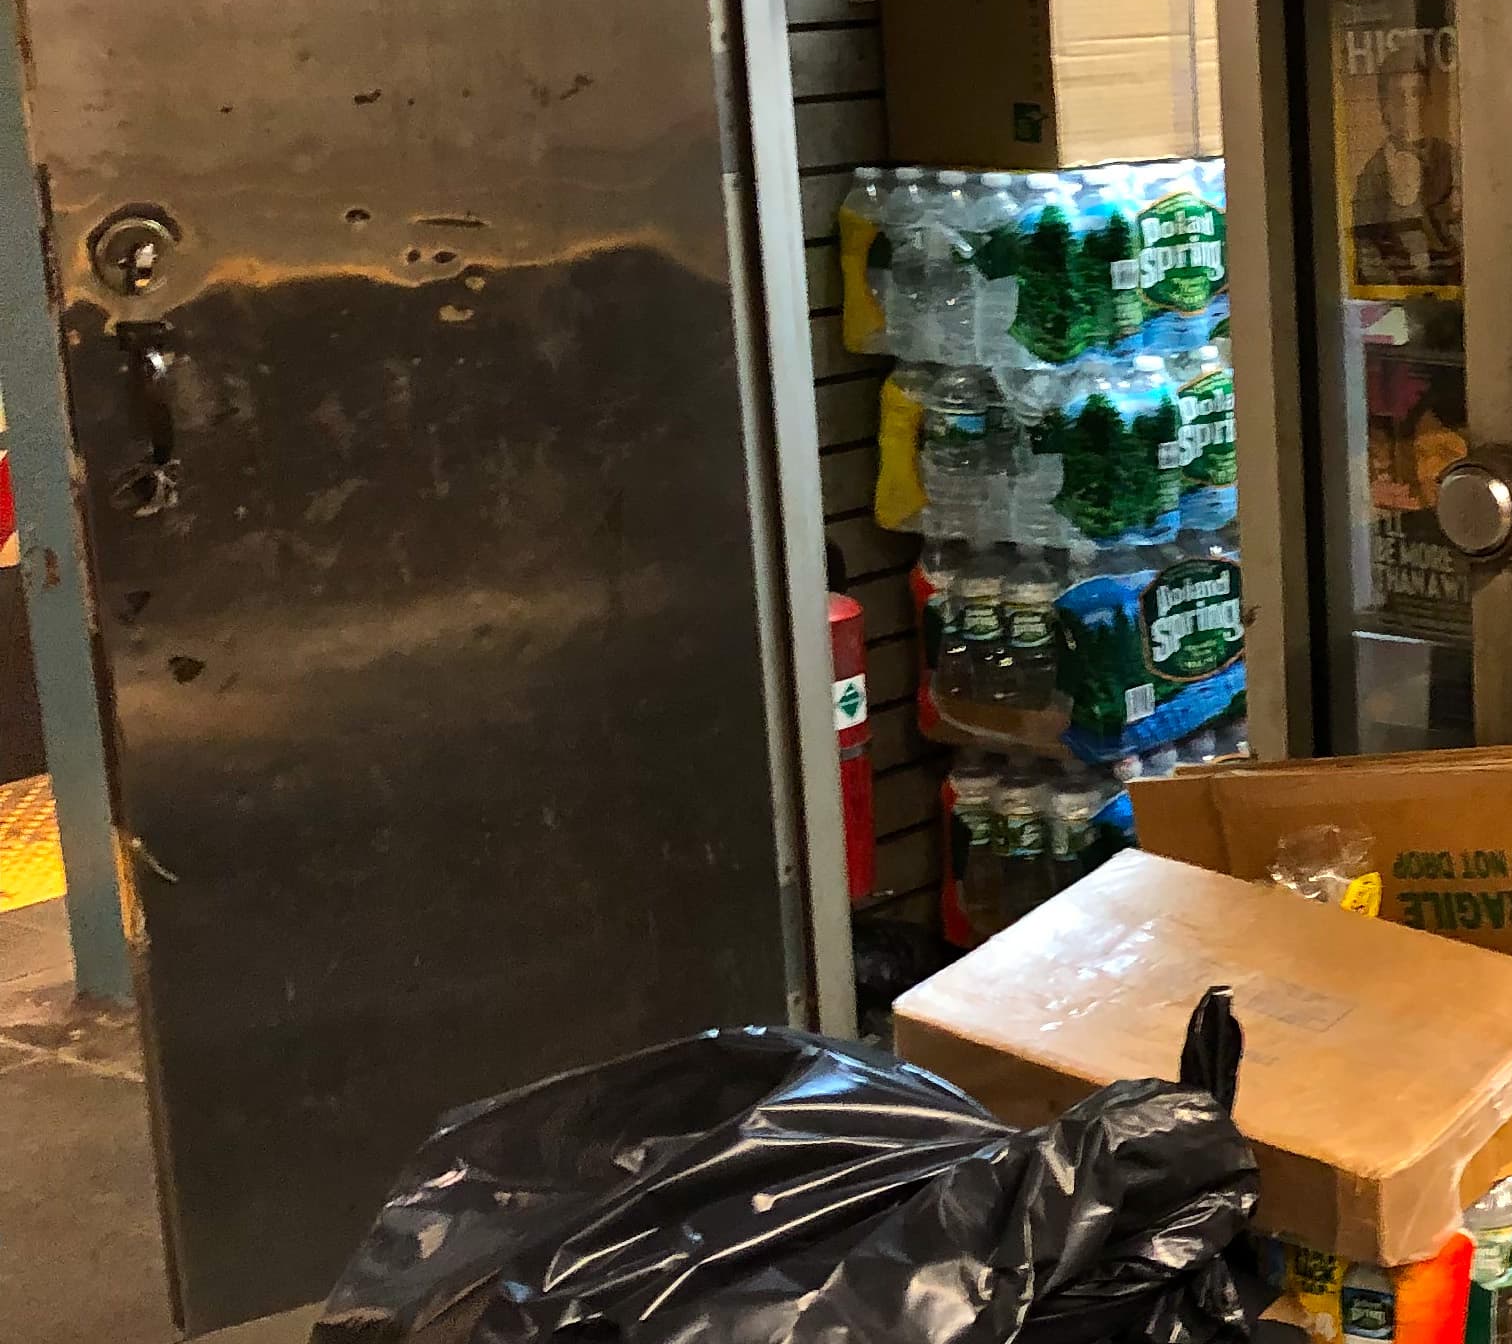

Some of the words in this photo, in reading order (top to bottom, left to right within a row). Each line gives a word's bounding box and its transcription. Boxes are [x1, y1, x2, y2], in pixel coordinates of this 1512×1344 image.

[1156, 569, 1231, 617] Poland
[1150, 598, 1245, 663] Spring
[1392, 849, 1456, 880] DROP
[1461, 849, 1509, 879] NOT
